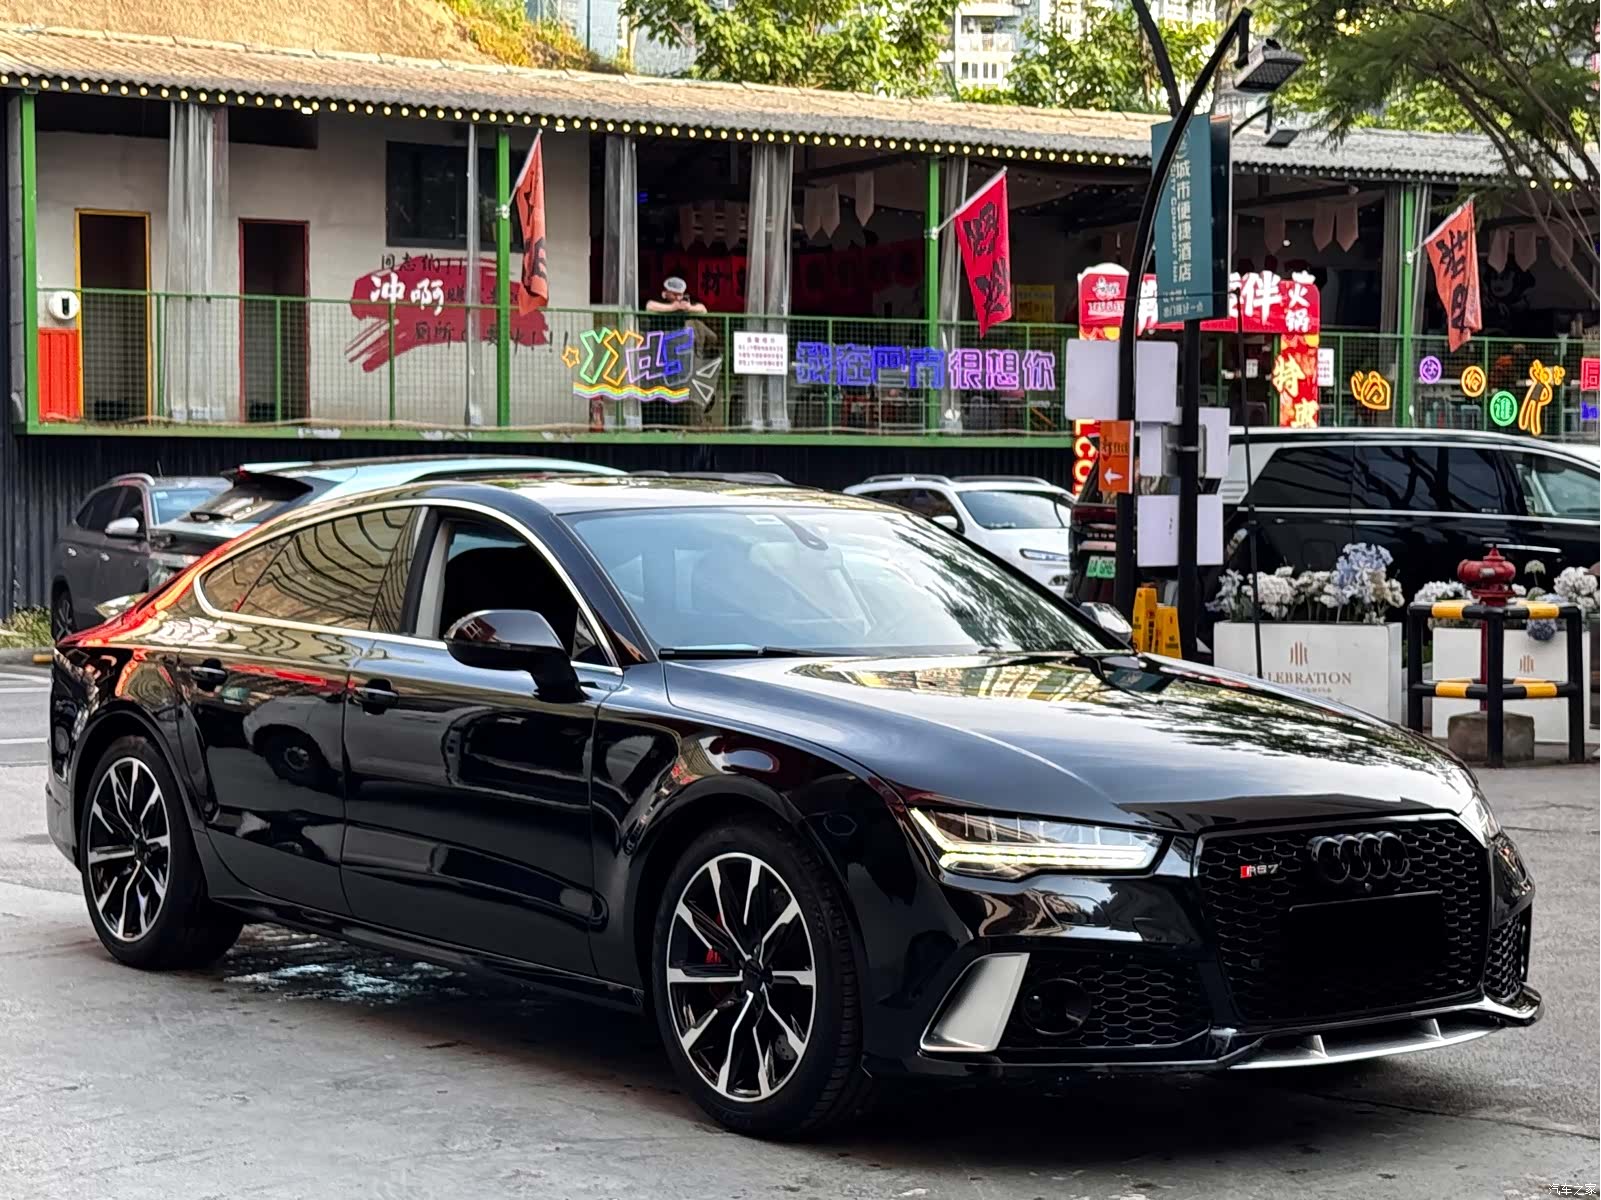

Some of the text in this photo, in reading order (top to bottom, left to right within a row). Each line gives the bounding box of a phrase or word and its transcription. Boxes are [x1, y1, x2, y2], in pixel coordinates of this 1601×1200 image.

[1176, 160, 1191, 282] 城市便捷酒店
[370, 272, 444, 316] 冲啊
[1285, 283, 1311, 333] 火锅
